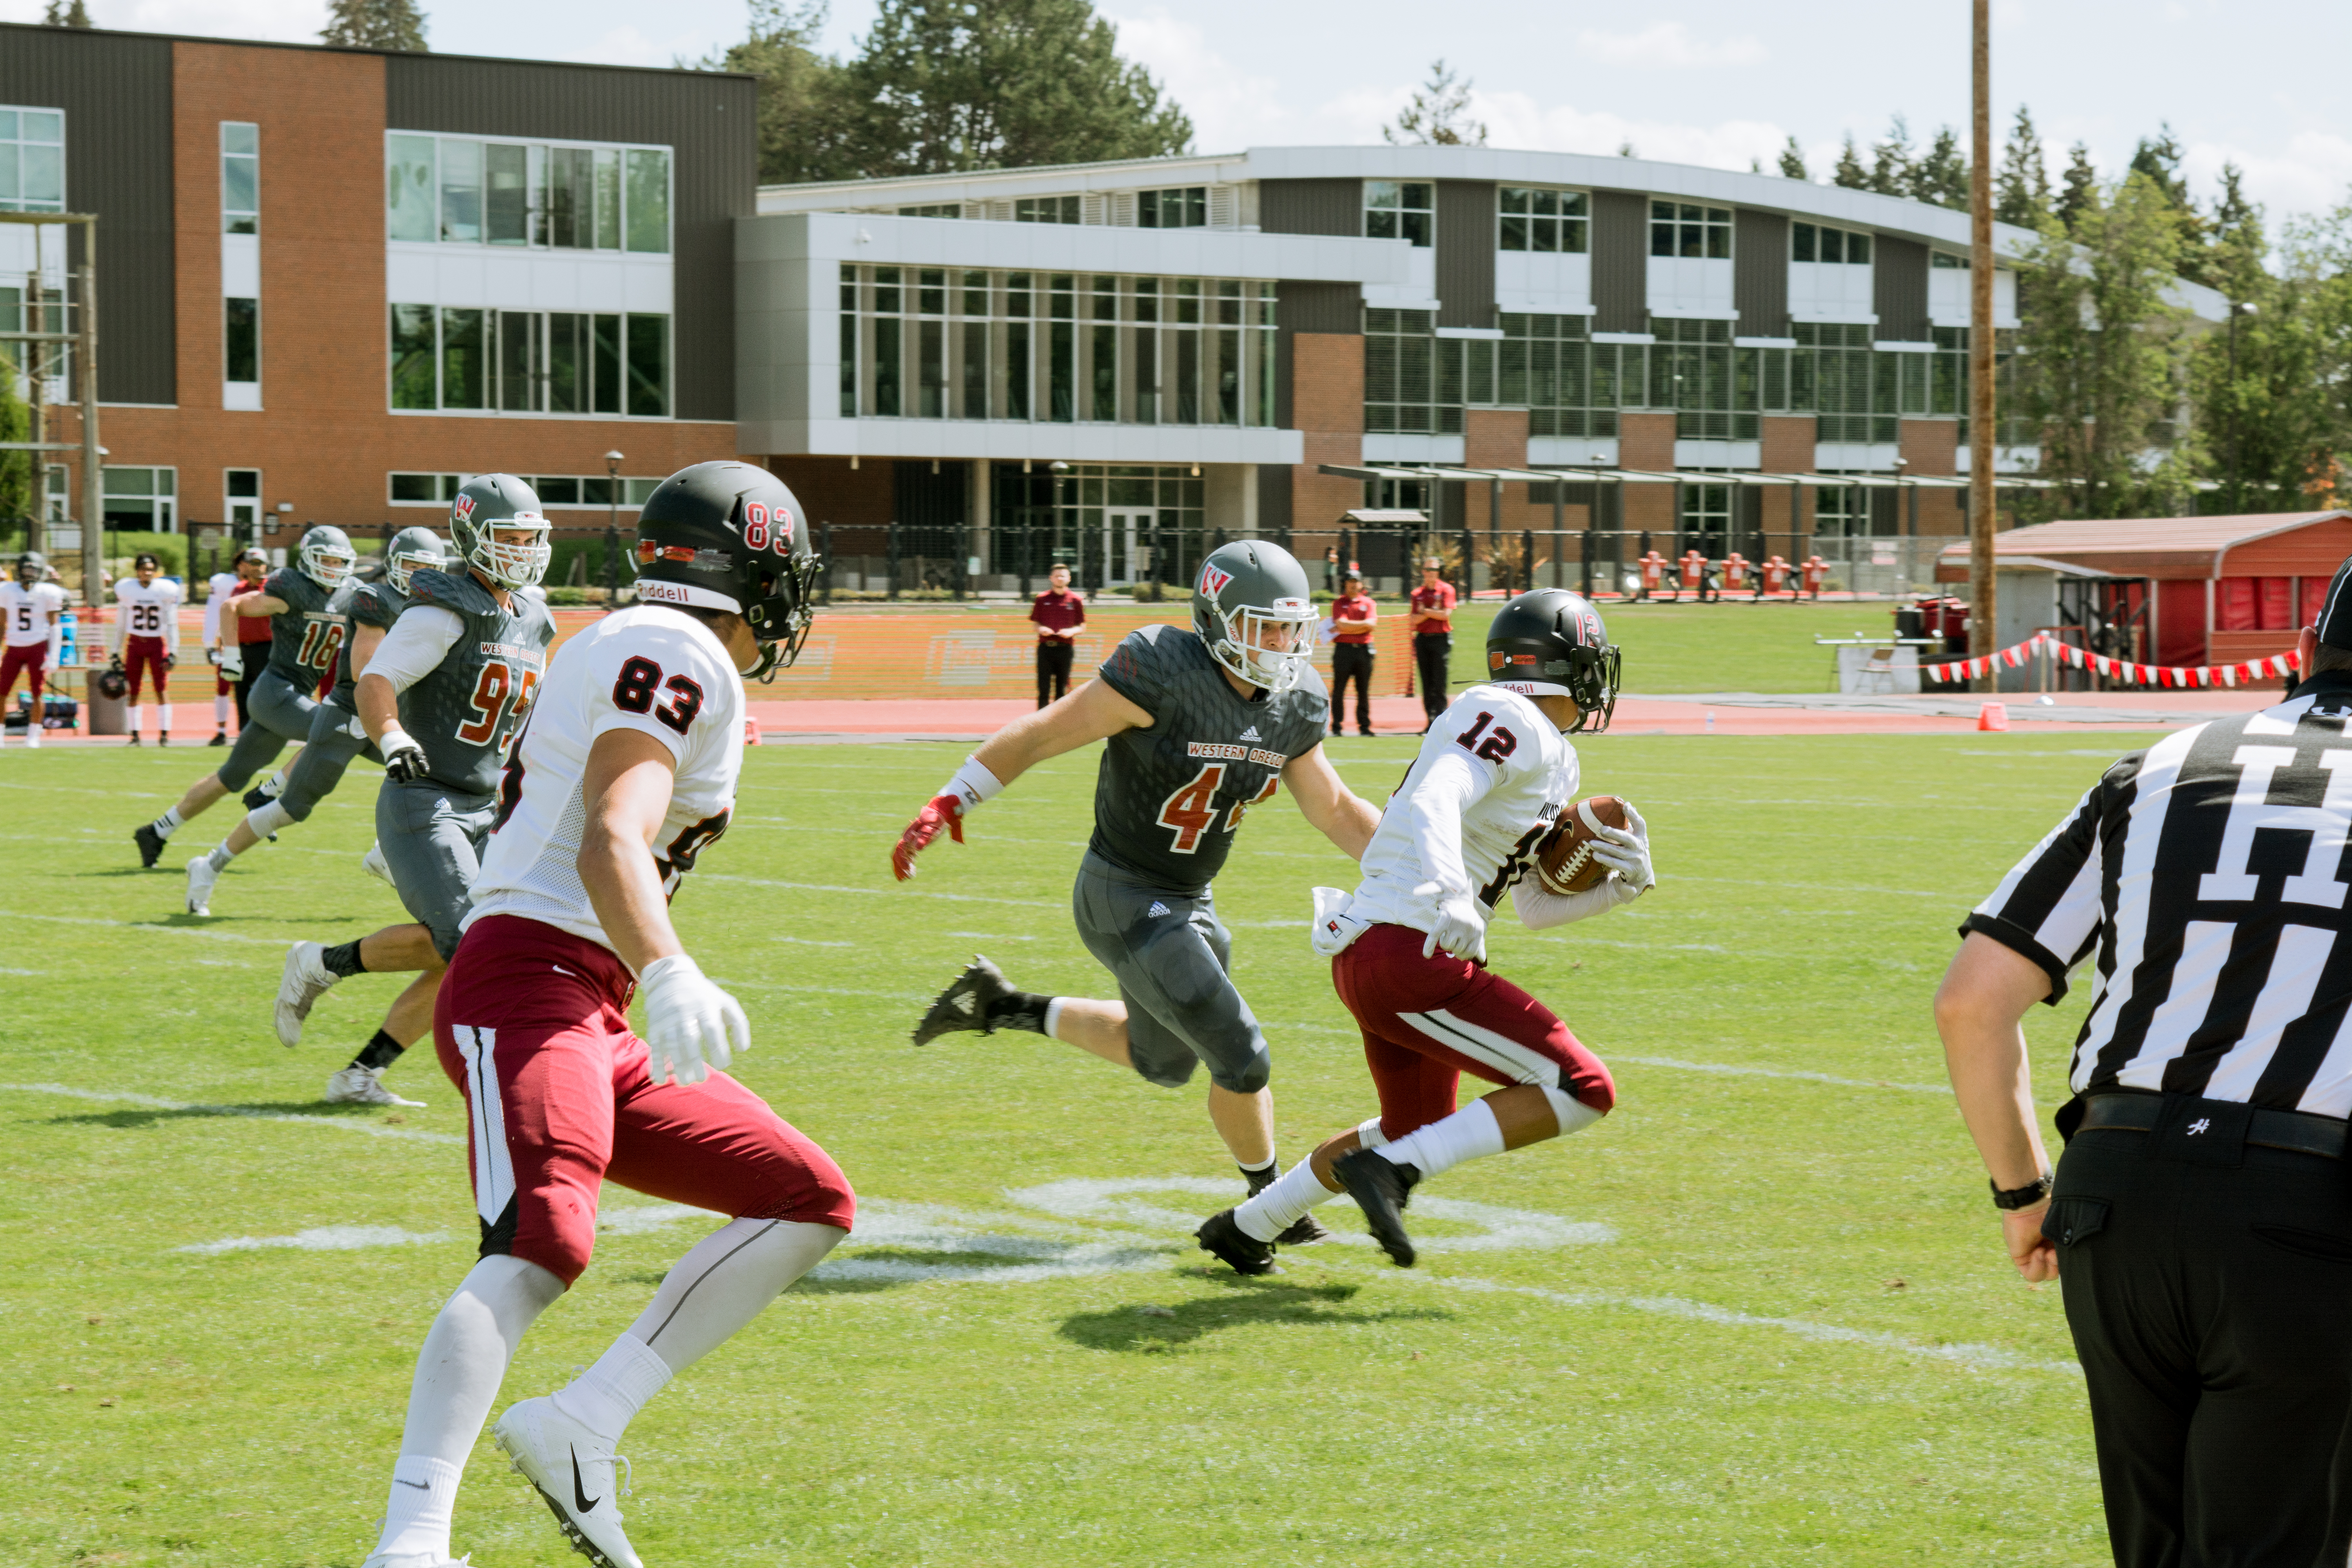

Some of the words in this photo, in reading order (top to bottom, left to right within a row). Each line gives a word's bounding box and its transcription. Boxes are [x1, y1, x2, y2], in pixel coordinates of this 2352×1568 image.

[744, 501, 794, 557] 83
[18, 608, 31, 631] 5
[133, 605, 159, 630] 26
[1571, 611, 1601, 650] 12
[296, 621, 346, 669] 18
[481, 642, 519, 659] WESTERN
[454, 659, 539, 753] 95
[612, 655, 704, 735] 83
[1188, 742, 1249, 760] WESTERN
[1456, 711, 1517, 765] 12
[2197, 745, 2352, 909] H
[1148, 908, 1171, 918] adidas
